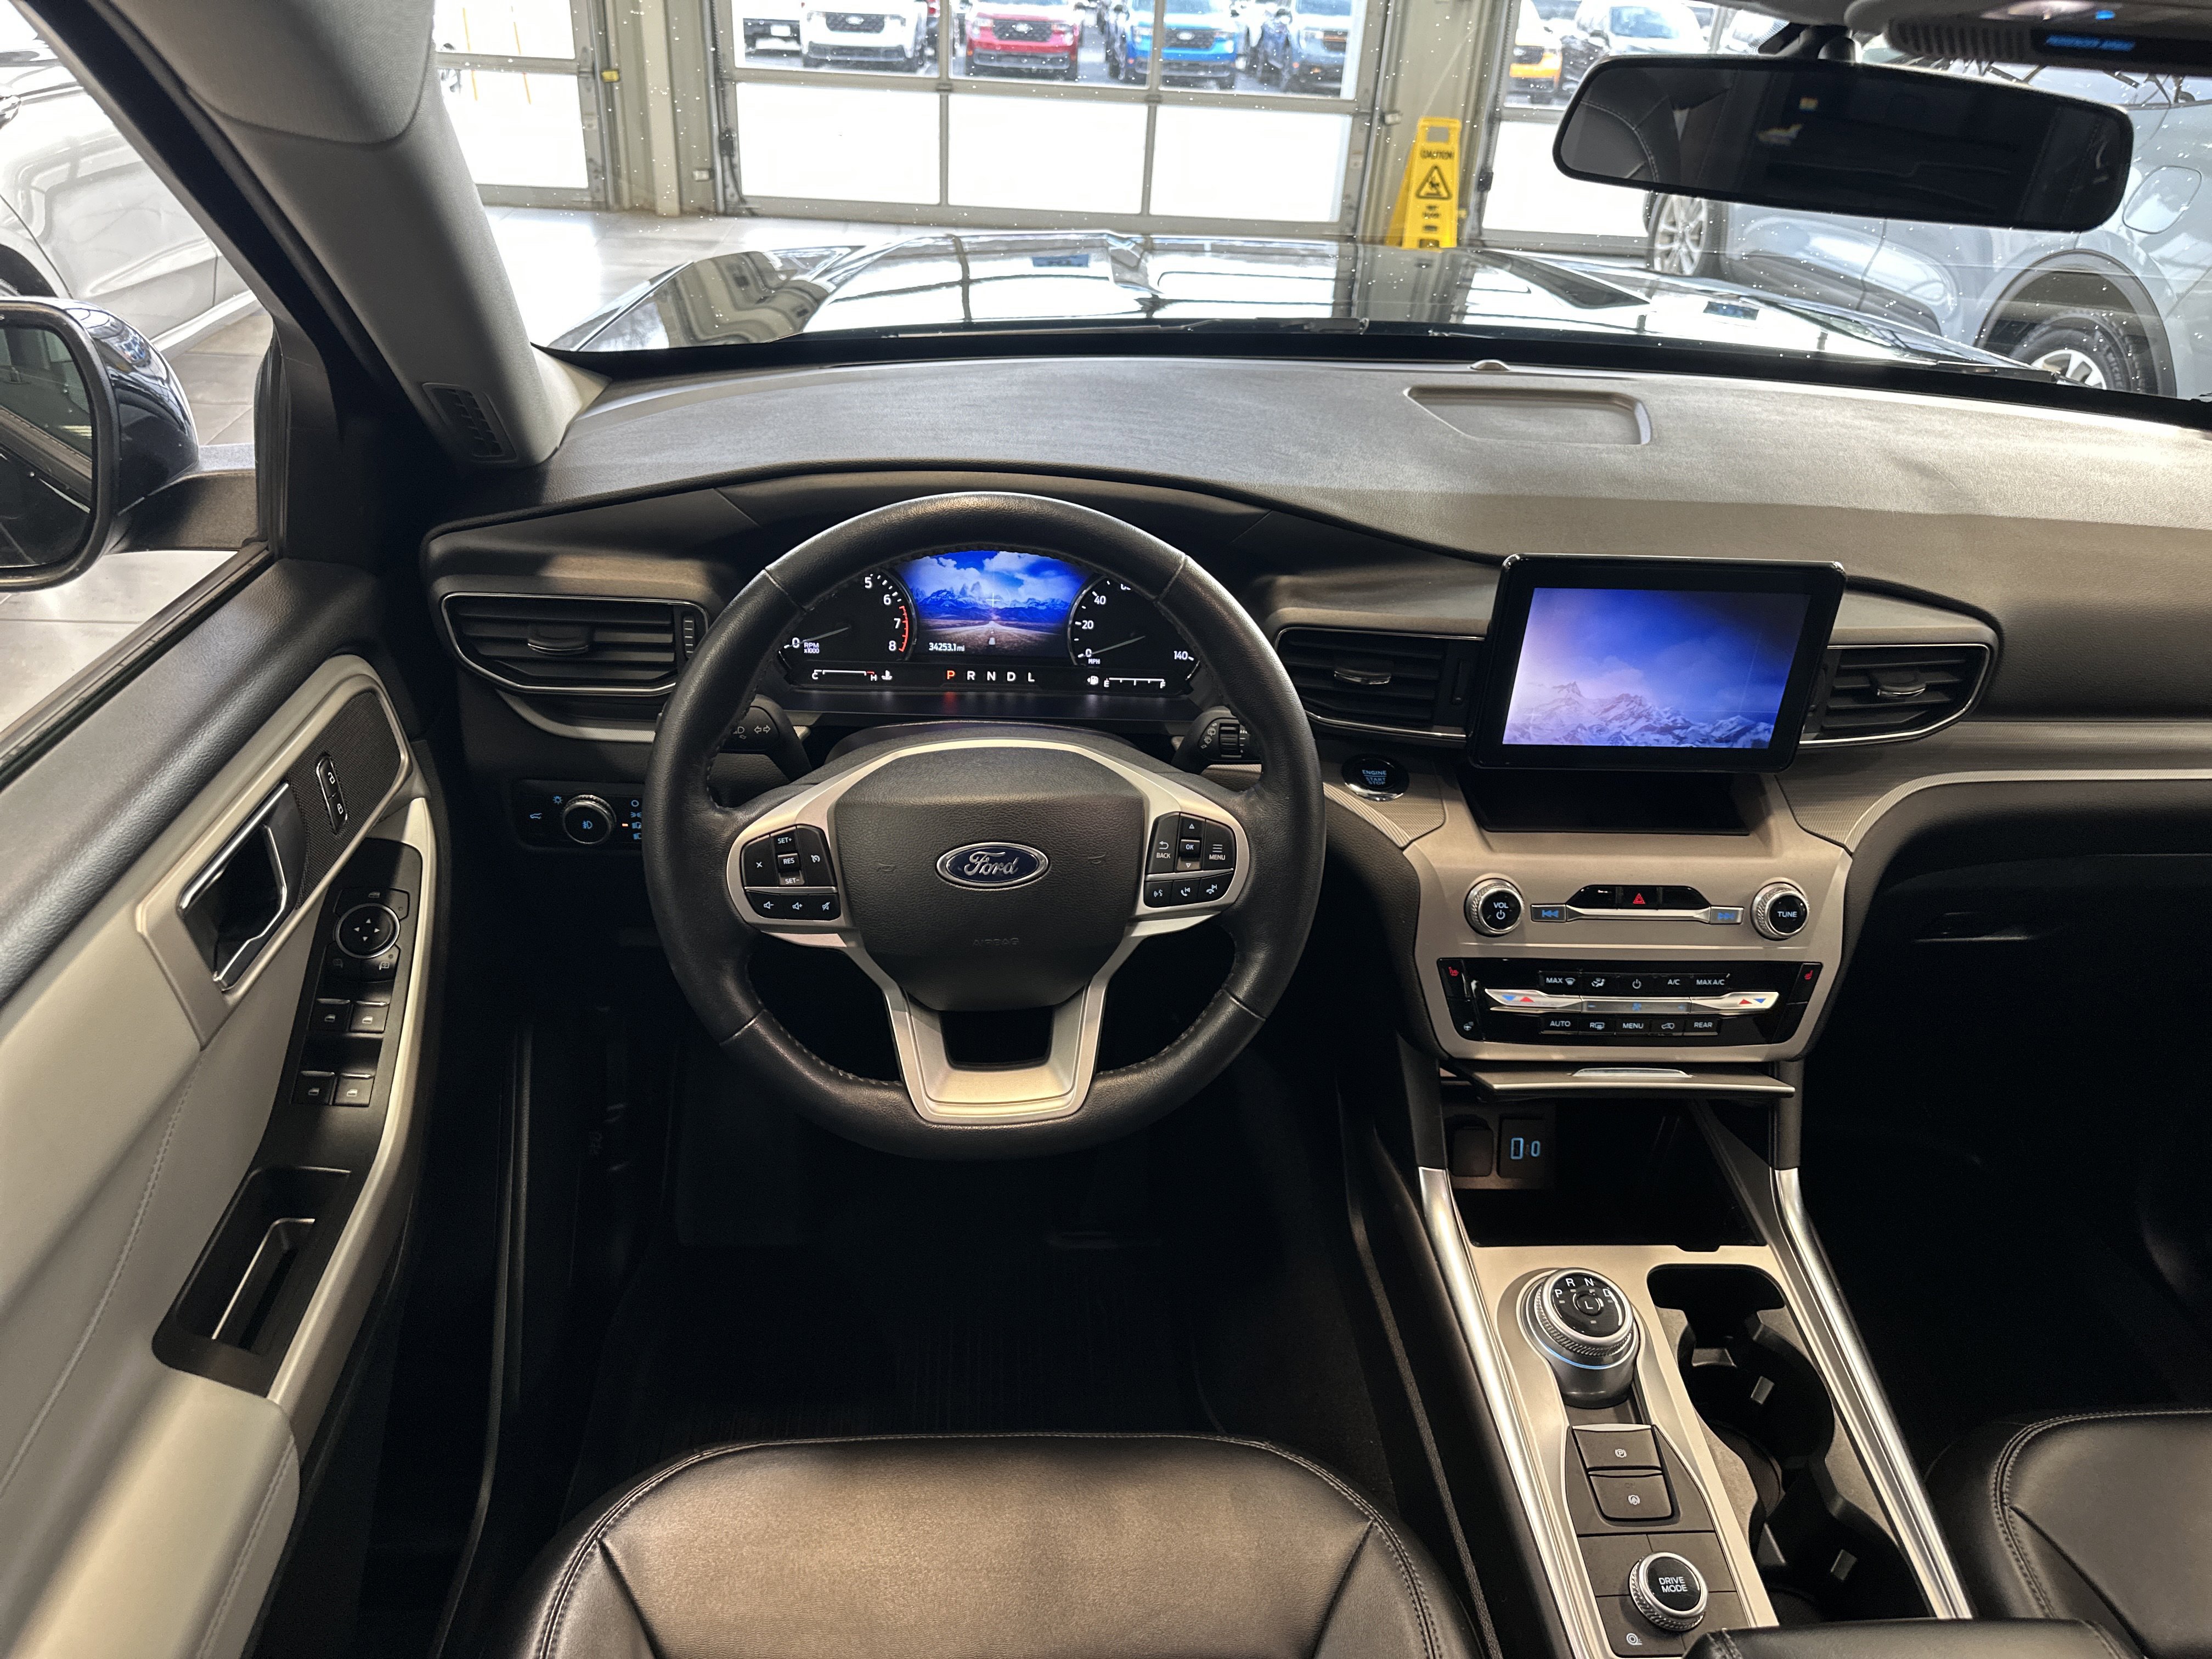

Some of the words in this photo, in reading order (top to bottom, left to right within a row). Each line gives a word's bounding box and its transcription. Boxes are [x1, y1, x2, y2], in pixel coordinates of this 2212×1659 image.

[864, 577, 873, 589] 5
[883, 594, 891, 605] 6
[1094, 595, 1106, 605] 40
[893, 618, 901, 629] 7
[1082, 620, 1094, 629] 20
[792, 637, 800, 648] 0
[888, 640, 896, 651] 8
[929, 642, 956, 651] 34253.1
[1085, 648, 1092, 658] 0
[1174, 651, 1188, 660] 140
[946, 670, 956, 680] P
[967, 670, 975, 680] R
[987, 671, 996, 681] N
[1007, 672, 1015, 681] D
[1028, 672, 1035, 682] L
[964, 851, 1020, 876] Ford
[1554, 1289, 1562, 1298] P
[1565, 1278, 1576, 1286] R
[1584, 1278, 1594, 1286] N
[1584, 1301, 1593, 1310] L
[1658, 1576, 1685, 1585] DRIVE
[1661, 1584, 1688, 1593] MODE
